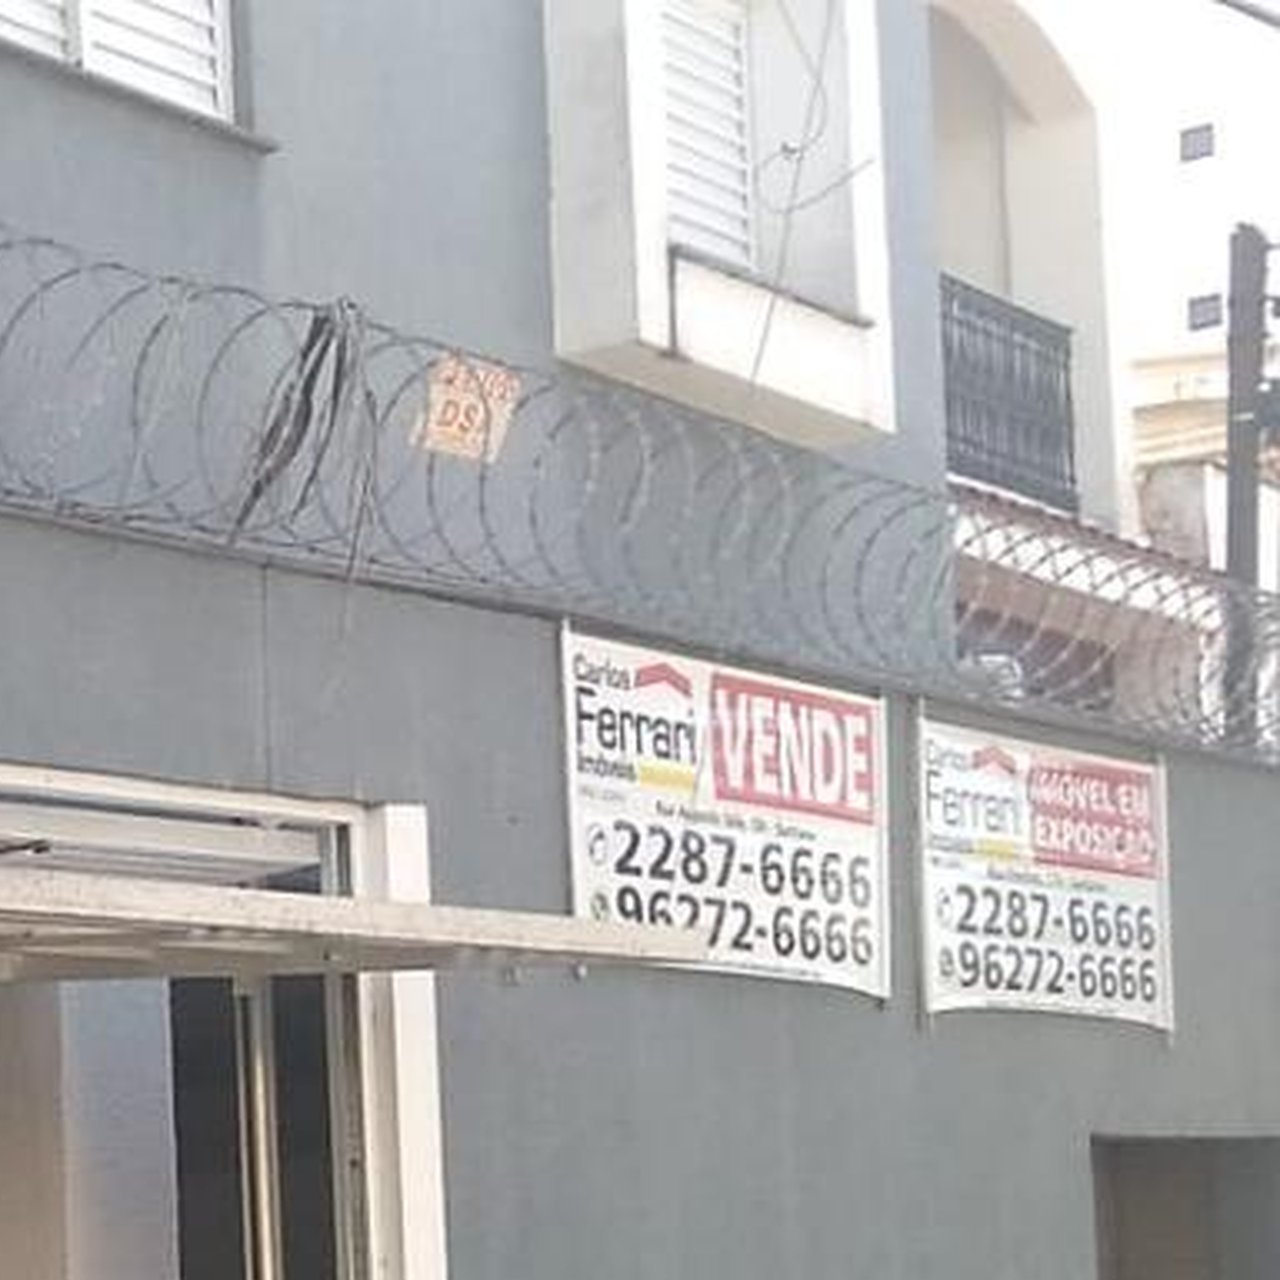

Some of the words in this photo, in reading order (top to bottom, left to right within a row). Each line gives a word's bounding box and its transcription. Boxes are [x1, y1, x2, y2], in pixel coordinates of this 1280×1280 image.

[575, 685, 698, 766] Ferrari
[719, 688, 870, 806] VENDE
[612, 818, 871, 908] 2287-6666
[955, 884, 1156, 951] 2287-6666
[958, 941, 1157, 1003] 96272-6666
